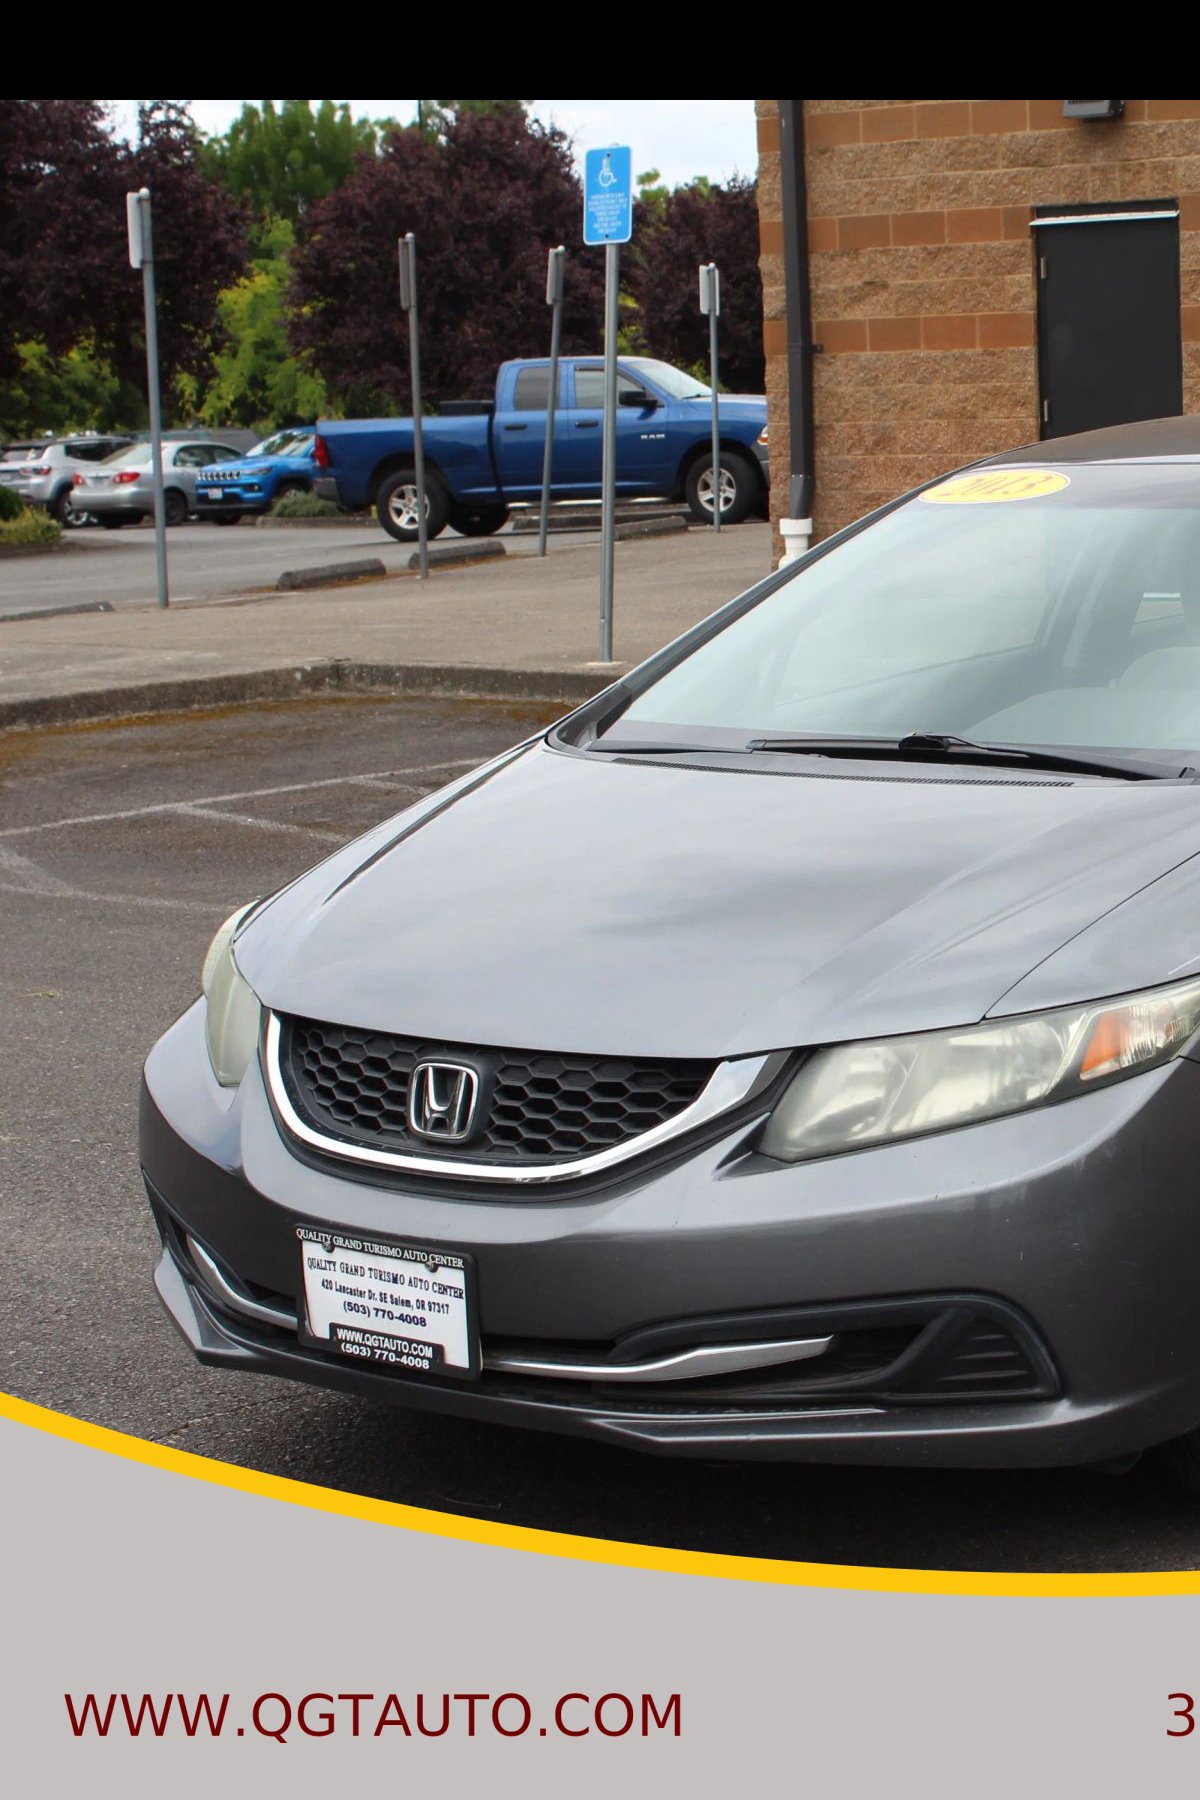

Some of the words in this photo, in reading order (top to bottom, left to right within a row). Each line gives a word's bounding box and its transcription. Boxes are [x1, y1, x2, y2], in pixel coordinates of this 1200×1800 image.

[296, 1228, 332, 1243] QUALITY
[332, 1236, 362, 1250] GRAND
[363, 1242, 402, 1257] TURISMO
[402, 1249, 428, 1262] AUTO
[429, 1253, 465, 1269] CENTER
[307, 1257, 337, 1272] QUALITY
[340, 1262, 366, 1277] GRAND
[368, 1267, 405, 1285] TURISMO
[408, 1276, 430, 1291] AUTO
[432, 1281, 465, 1299] CENTER
[335, 1281, 367, 1299] Lancaster
[368, 1289, 378, 1301] Dr.
[379, 1292, 388, 1304] SE
[389, 1294, 414, 1311] Salem,
[415, 1298, 426, 1311] OR
[427, 1301, 450, 1315] 97317
[343, 1300, 371, 1318] (503)
[372, 1307, 427, 1327] 770-4008
[336, 1327, 433, 1359] WWW.QGTAUTO.COM
[341, 1342, 371, 1358] (503)
[374, 1349, 430, 1370] 770-4008
